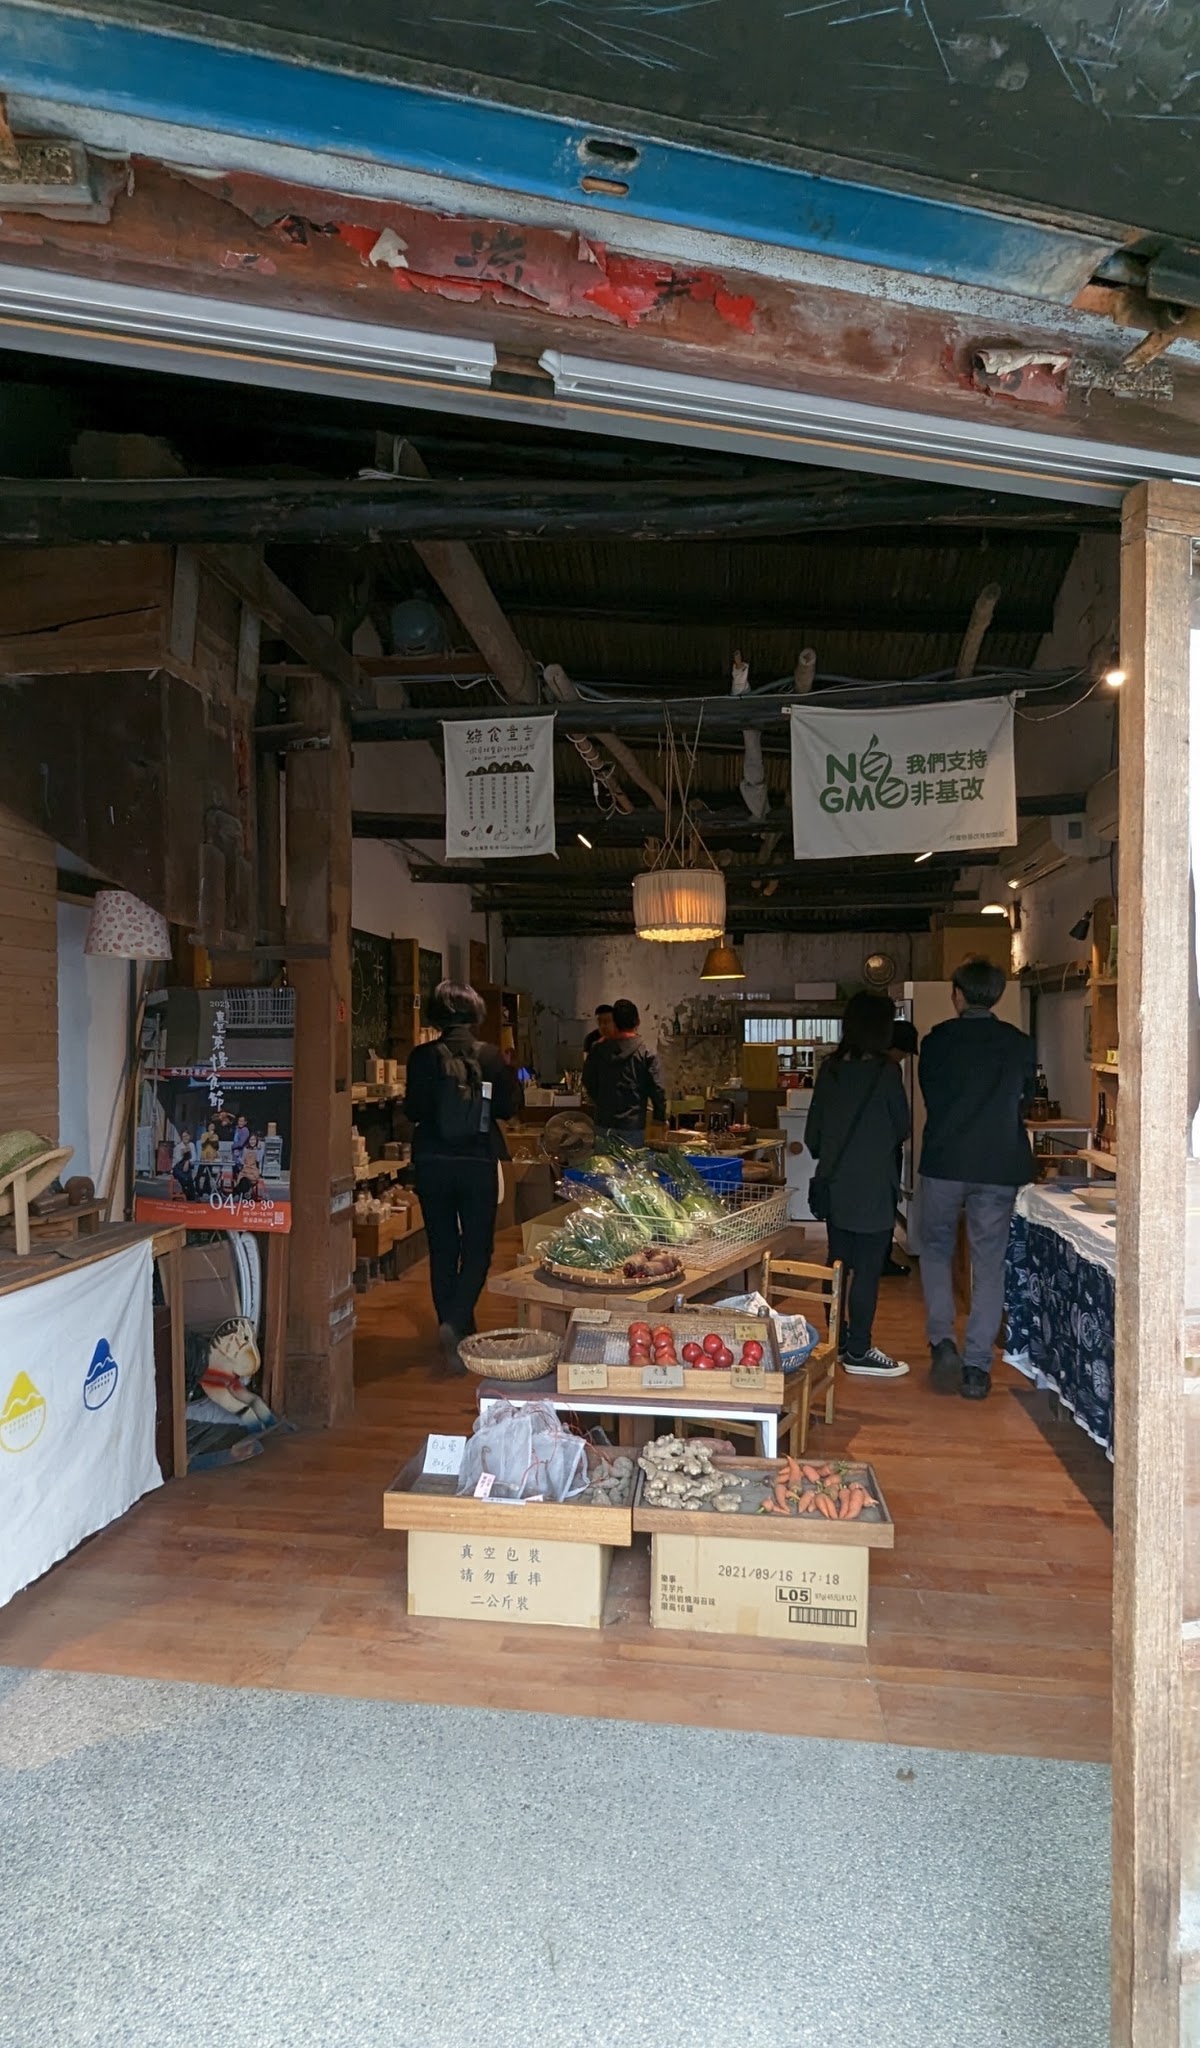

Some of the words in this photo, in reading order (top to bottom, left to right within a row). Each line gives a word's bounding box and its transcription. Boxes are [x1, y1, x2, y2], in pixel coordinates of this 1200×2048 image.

[906, 749, 988, 775] 我們支持
[910, 776, 985, 806] 非基改
[460, 1543, 542, 1563] 真空包裝
[717, 1565, 794, 1582] 2021/09/16
[801, 1571, 840, 1586] 17:18
[470, 1593, 529, 1611] 二公斤裝
[778, 1588, 809, 1602] L05
